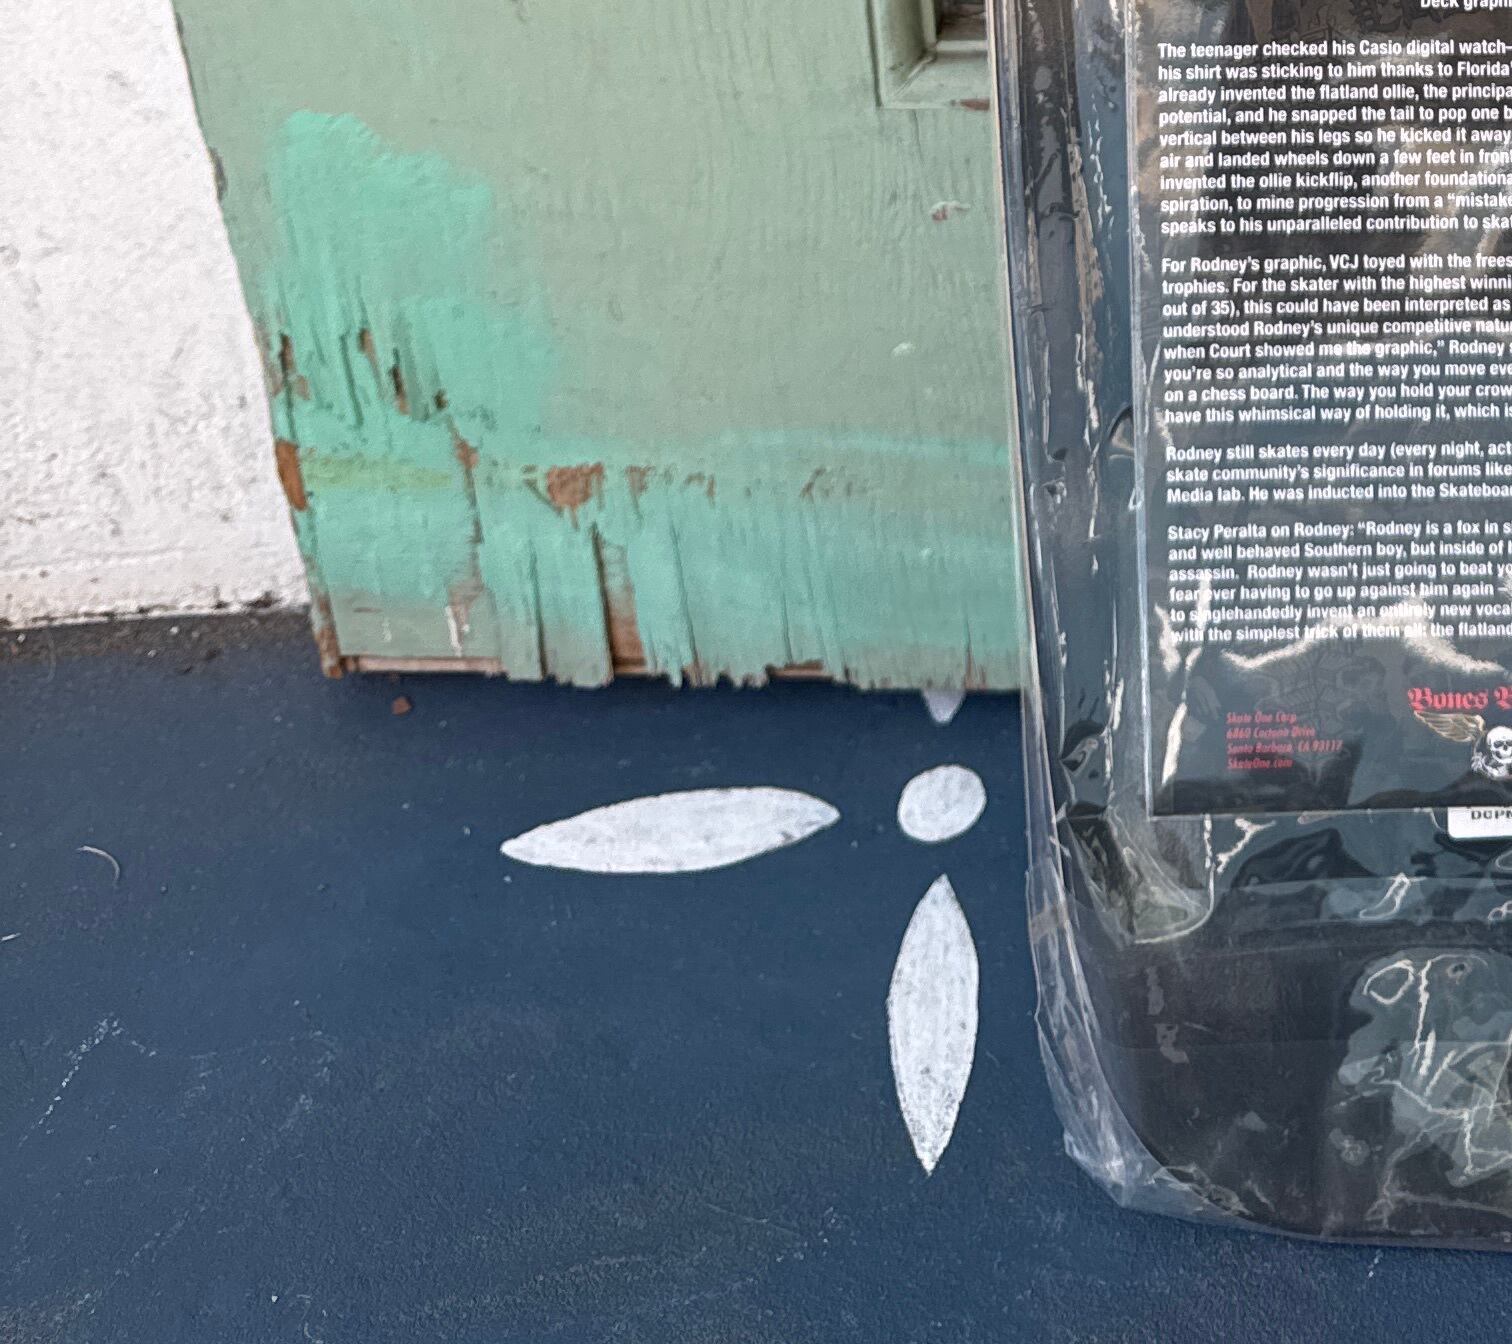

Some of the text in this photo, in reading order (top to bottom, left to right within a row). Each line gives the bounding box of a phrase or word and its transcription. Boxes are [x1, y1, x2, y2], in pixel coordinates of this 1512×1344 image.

[1157, 42, 1187, 58] The
[1190, 42, 1259, 60] teenager
[1262, 39, 1328, 57] checked
[1332, 39, 1356, 56] his
[1359, 39, 1402, 55] Casio
[1406, 38, 1455, 58] digital
[1161, 257, 1187, 274] For
[1190, 255, 1260, 275] Rodney's
[1263, 253, 1327, 274] graphic,
[1328, 253, 1359, 270] VCJ
[1362, 253, 1406, 272] toyed
[1409, 252, 1443, 269] with
[1446, 252, 1472, 268] the
[1166, 486, 1214, 504] Media
[1216, 486, 1245, 502] lab.
[1248, 485, 1269, 502] He
[1272, 487, 1305, 501] was
[1307, 483, 1374, 501] inducted
[1377, 482, 1408, 499] into
[1410, 482, 1436, 499] the
[1407, 687, 1489, 712] Bones
